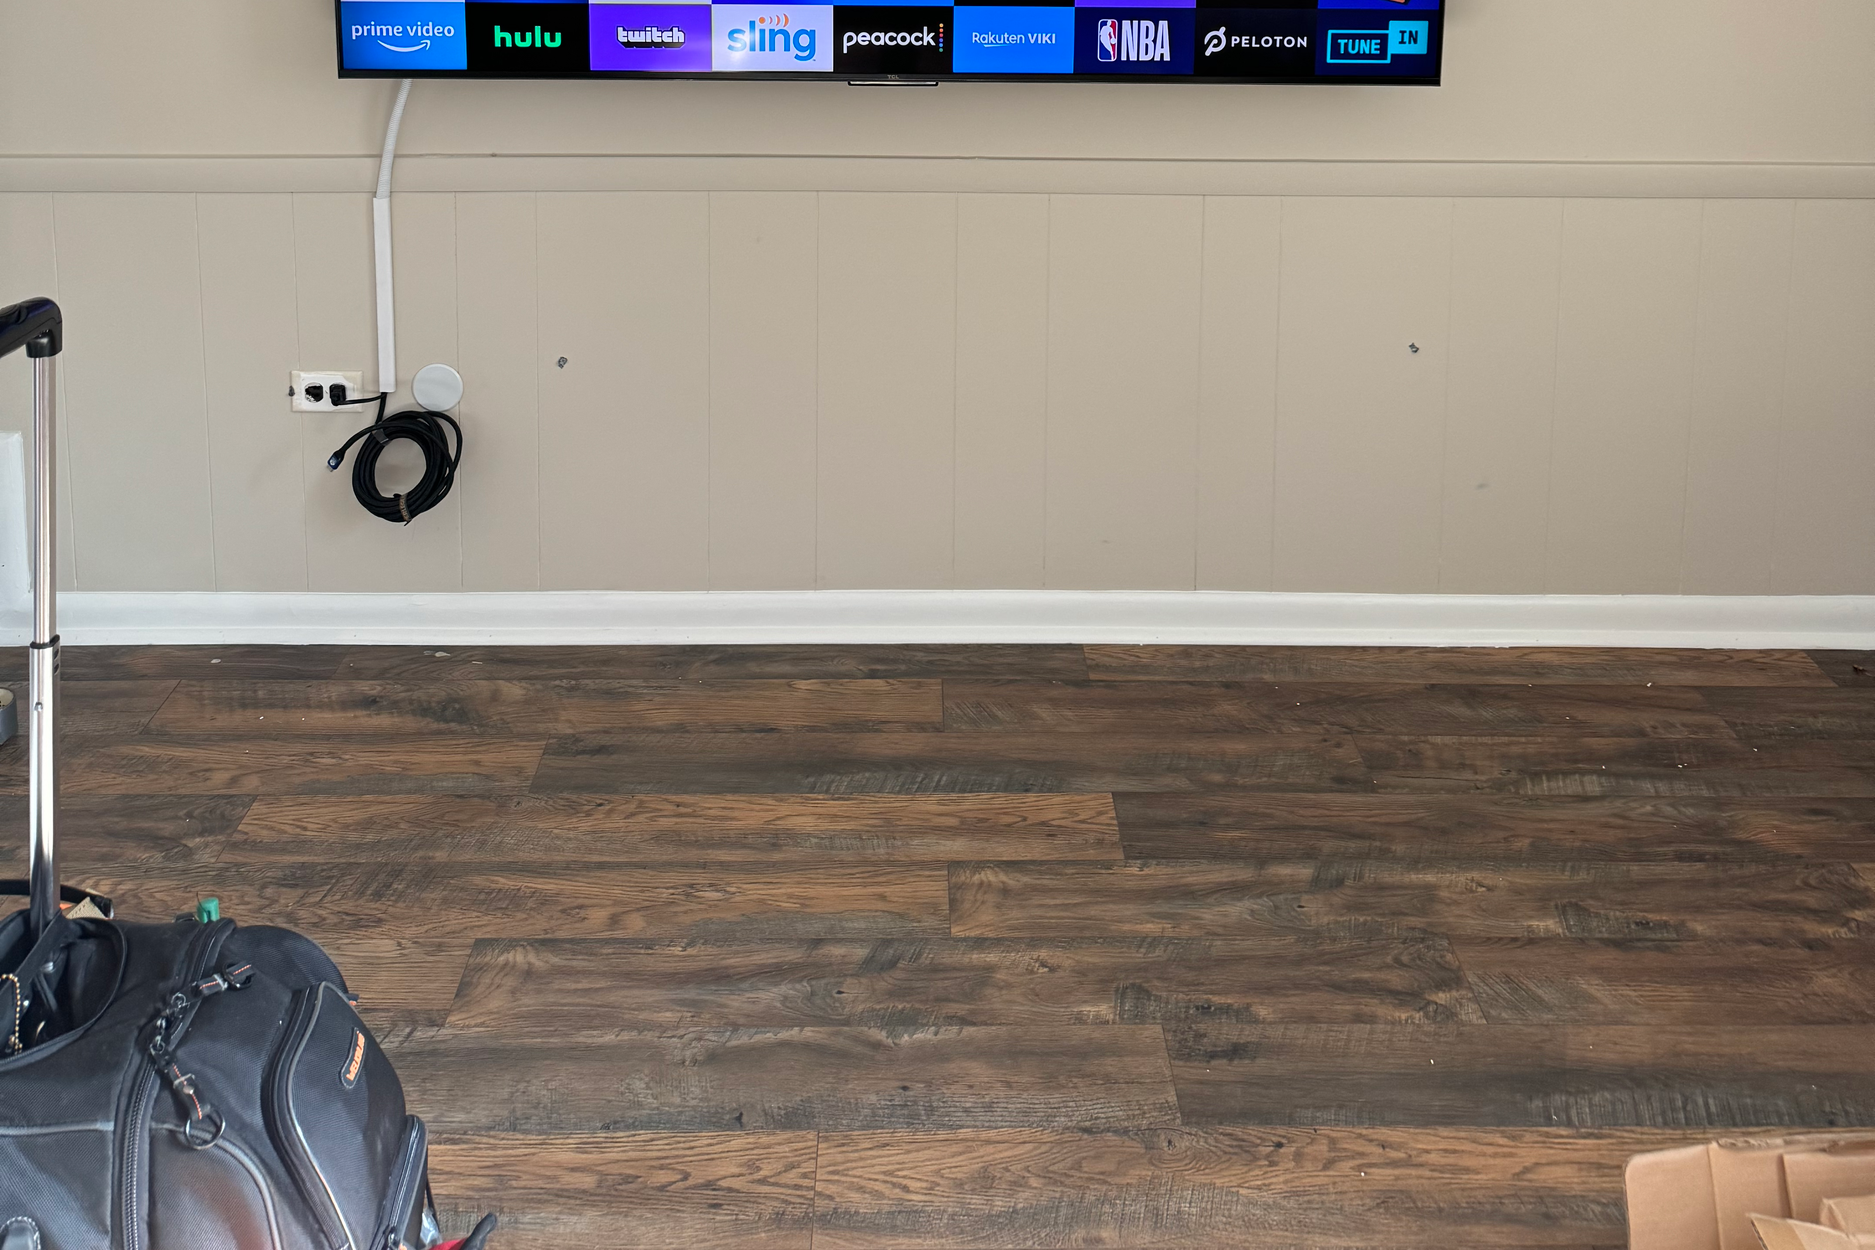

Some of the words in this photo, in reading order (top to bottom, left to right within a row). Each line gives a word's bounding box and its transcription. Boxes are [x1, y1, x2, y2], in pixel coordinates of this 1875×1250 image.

[351, 21, 403, 41] prime
[407, 21, 455, 38] video
[494, 25, 562, 48] hulu
[616, 25, 685, 45] twitch
[727, 17, 817, 62] sling
[843, 25, 936, 54] peacock
[972, 32, 1025, 44] Rakuten
[1028, 33, 1056, 44] VIKI
[1121, 19, 1170, 61] NBA
[1231, 35, 1307, 49] PELOTON
[1337, 39, 1381, 54] TUNE
[1398, 30, 1418, 45] IN
